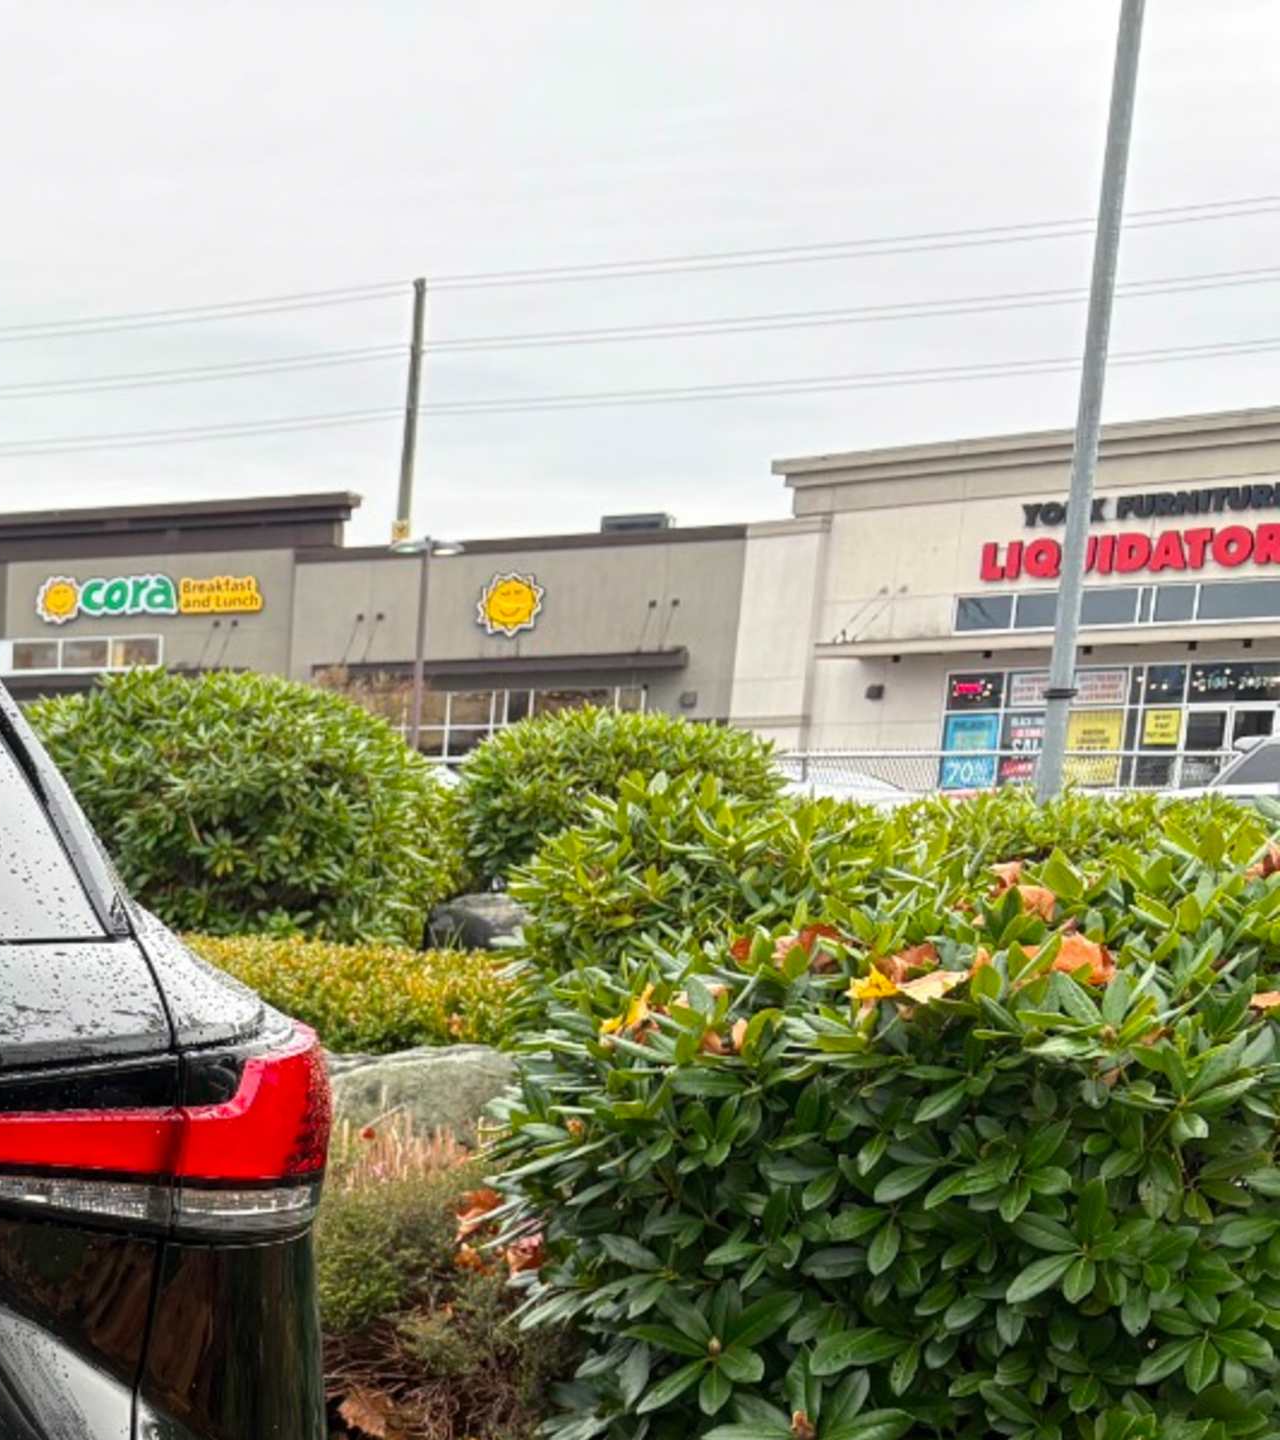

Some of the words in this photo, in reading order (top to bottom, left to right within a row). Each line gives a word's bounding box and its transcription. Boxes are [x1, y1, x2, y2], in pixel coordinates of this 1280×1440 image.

[1022, 498, 1107, 527] YOK
[1116, 481, 1280, 519] FURNITUR
[80, 576, 176, 612] cora
[182, 578, 253, 594] Breakfast
[183, 597, 211, 609] and
[216, 593, 259, 608] Lunch
